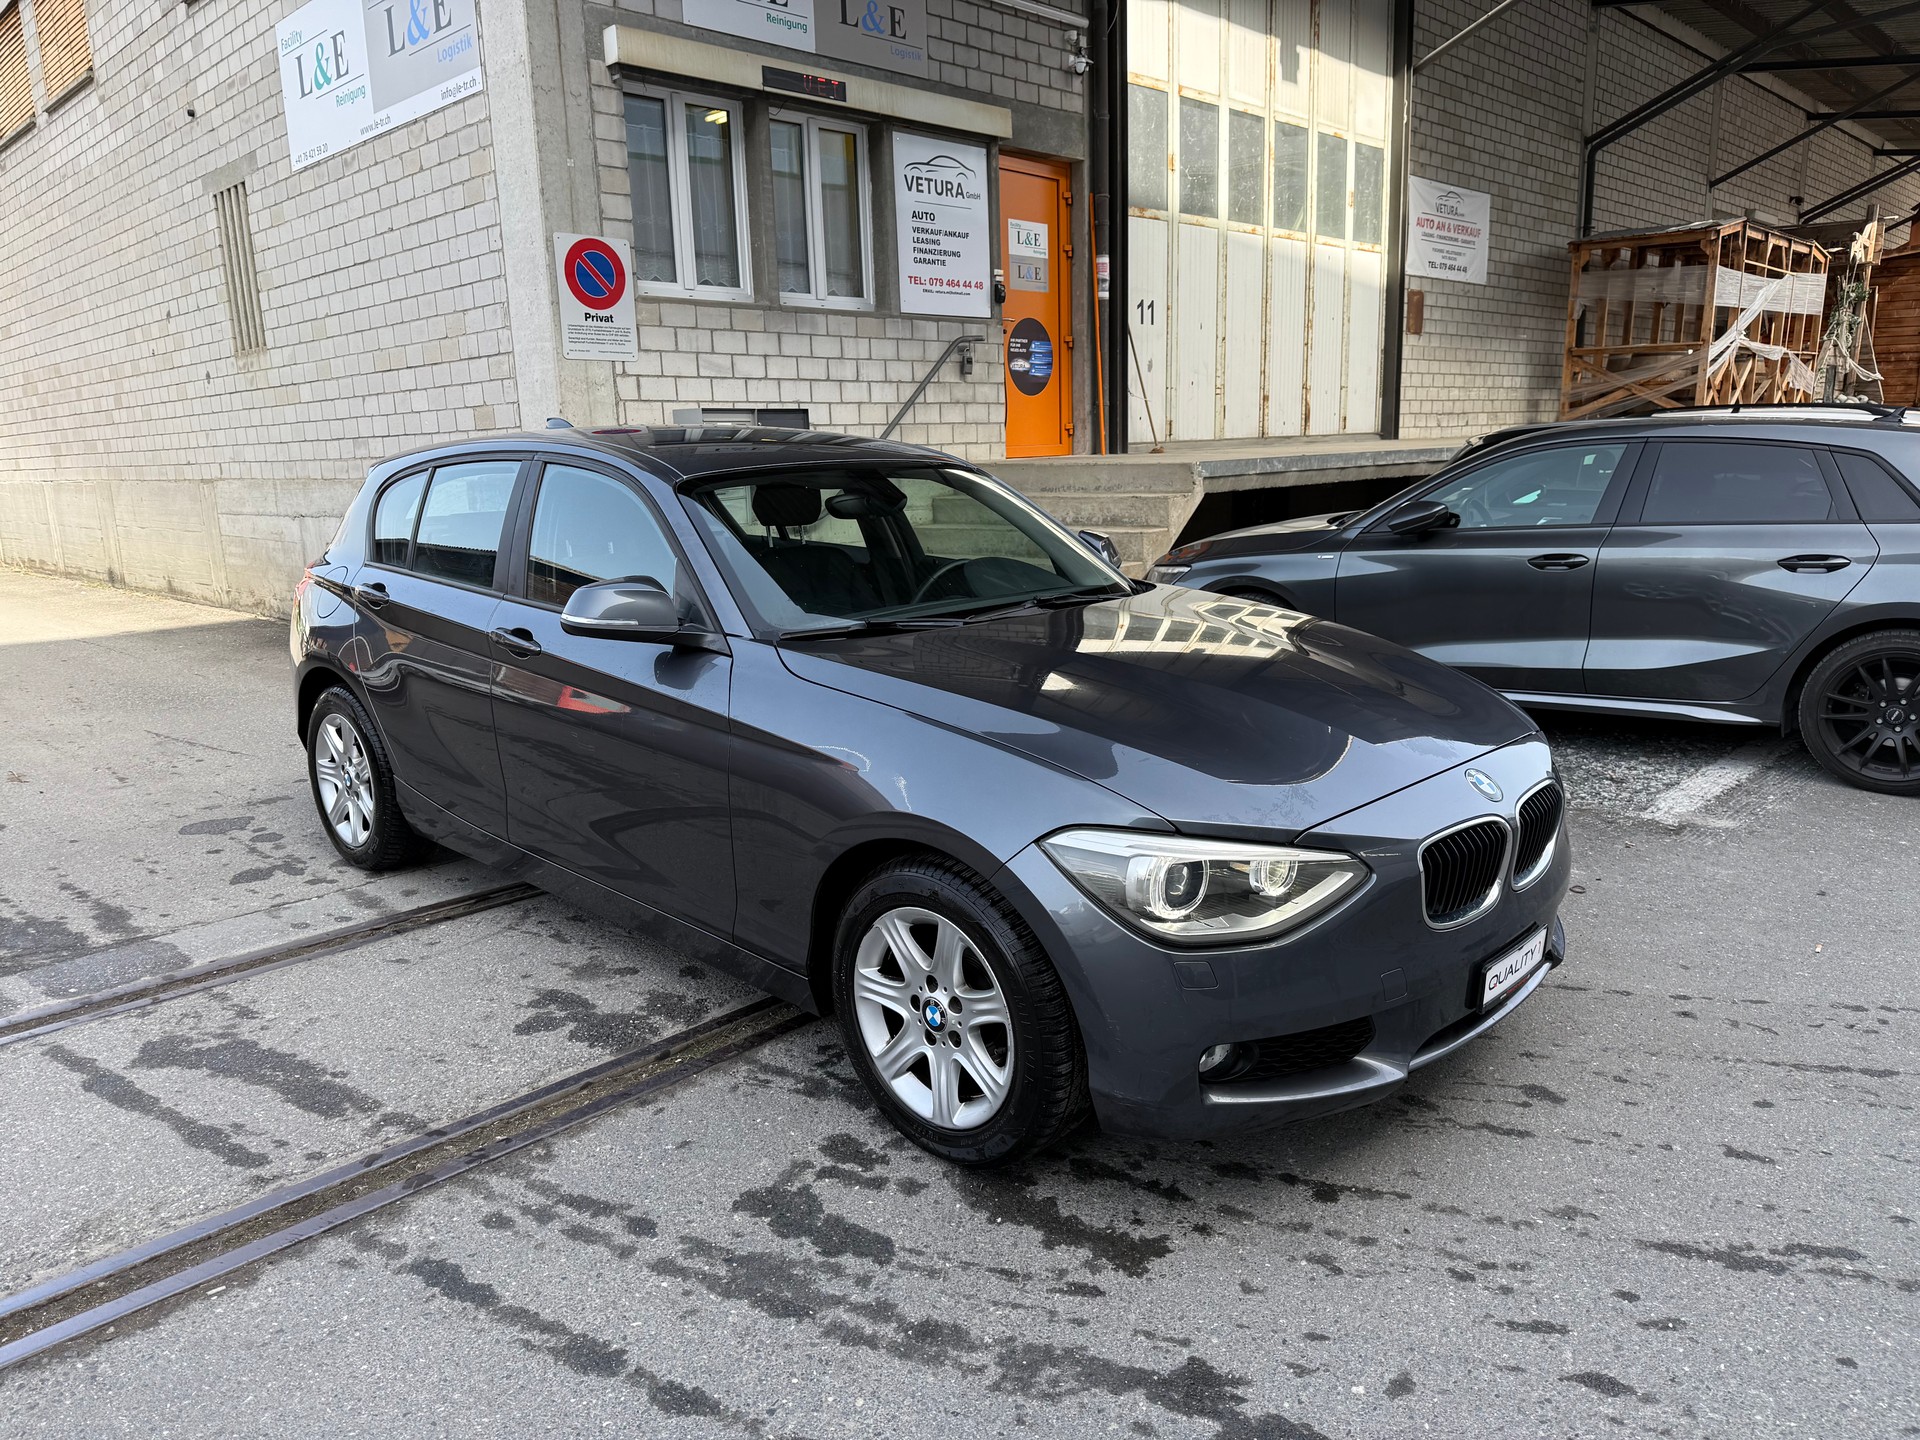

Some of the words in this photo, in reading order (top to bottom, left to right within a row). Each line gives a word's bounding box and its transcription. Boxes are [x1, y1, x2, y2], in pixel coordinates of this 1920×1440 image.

[766, 12, 808, 34] Reinigung
[838, 0, 907, 40] L&E
[280, 30, 303, 51] Facility
[437, 33, 473, 63] Logistik
[890, 45, 922, 61] Logistik
[295, 30, 349, 99] L&E
[335, 84, 366, 107] Reinigung
[440, 76, 477, 101] info@le-tr.ch
[359, 114, 391, 136] www.le-tr.ch
[322, 142, 329, 153] 20
[904, 174, 965, 199] VETURA
[965, 191, 981, 200] GmbH
[911, 210, 936, 222] AUTO
[1435, 202, 1459, 217] VETURA
[911, 225, 970, 240] VERKAUF/ANKAUF
[1416, 216, 1435, 230] AUTO
[1436, 220, 1446, 232] AN
[1447, 222, 1452, 233] &
[1453, 223, 1482, 238] VERKAUF
[912, 236, 941, 247] LEASING
[1017, 230, 1041, 247] L&E
[912, 246, 961, 258] FINANZIERUNG
[913, 256, 947, 267] GARANTIE
[1428, 261, 1438, 269] TEL:
[1018, 264, 1042, 281] L&E
[908, 275, 927, 286] TEL:
[928, 277, 944, 287] 079
[945, 278, 961, 288] 464
[962, 280, 972, 289] 44
[973, 281, 984, 291] 48
[584, 312, 614, 323] Privat
[1136, 299, 1155, 325] 11
[1488, 944, 1537, 991] QUALITY
